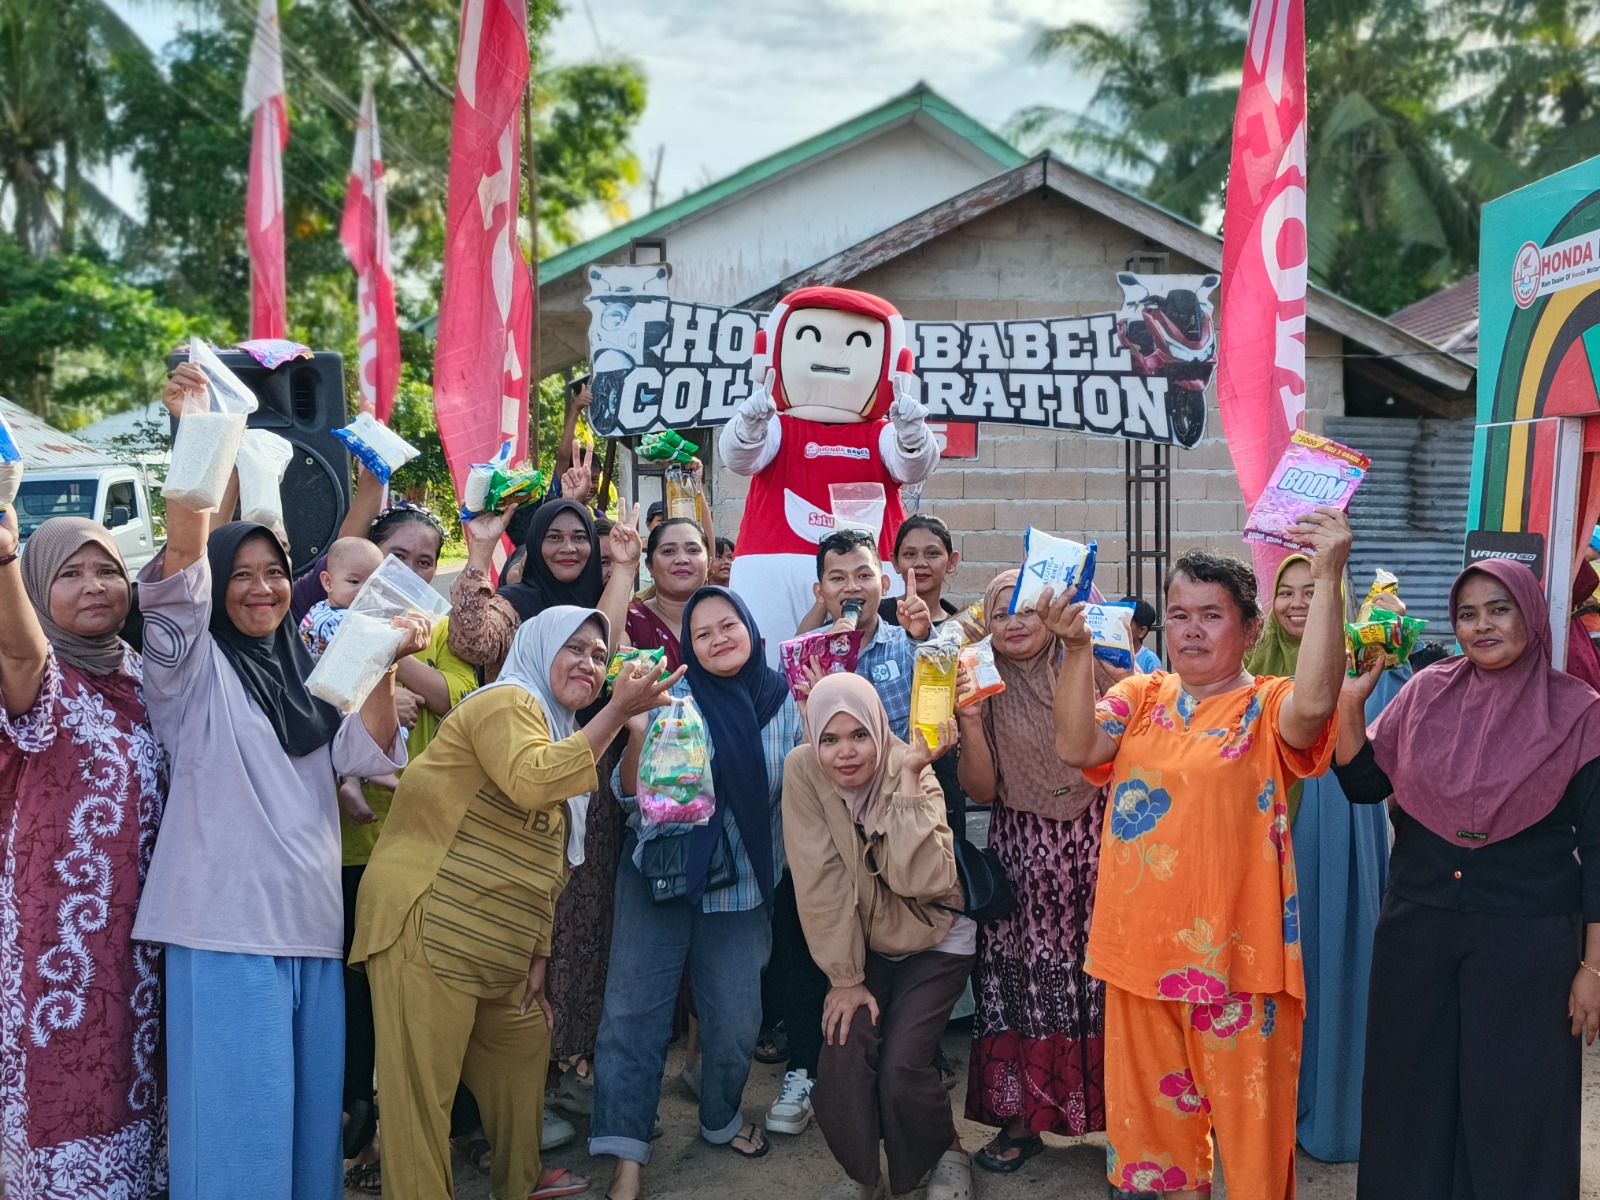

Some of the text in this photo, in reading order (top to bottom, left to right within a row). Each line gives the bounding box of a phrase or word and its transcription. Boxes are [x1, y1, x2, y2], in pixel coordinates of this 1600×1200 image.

[1542, 242, 1593, 275] HONDA
[918, 316, 1132, 371] BABEL
[1277, 467, 1349, 500] BOOM
[808, 512, 834, 528] Satu
[1471, 549, 1518, 560] VARIO
